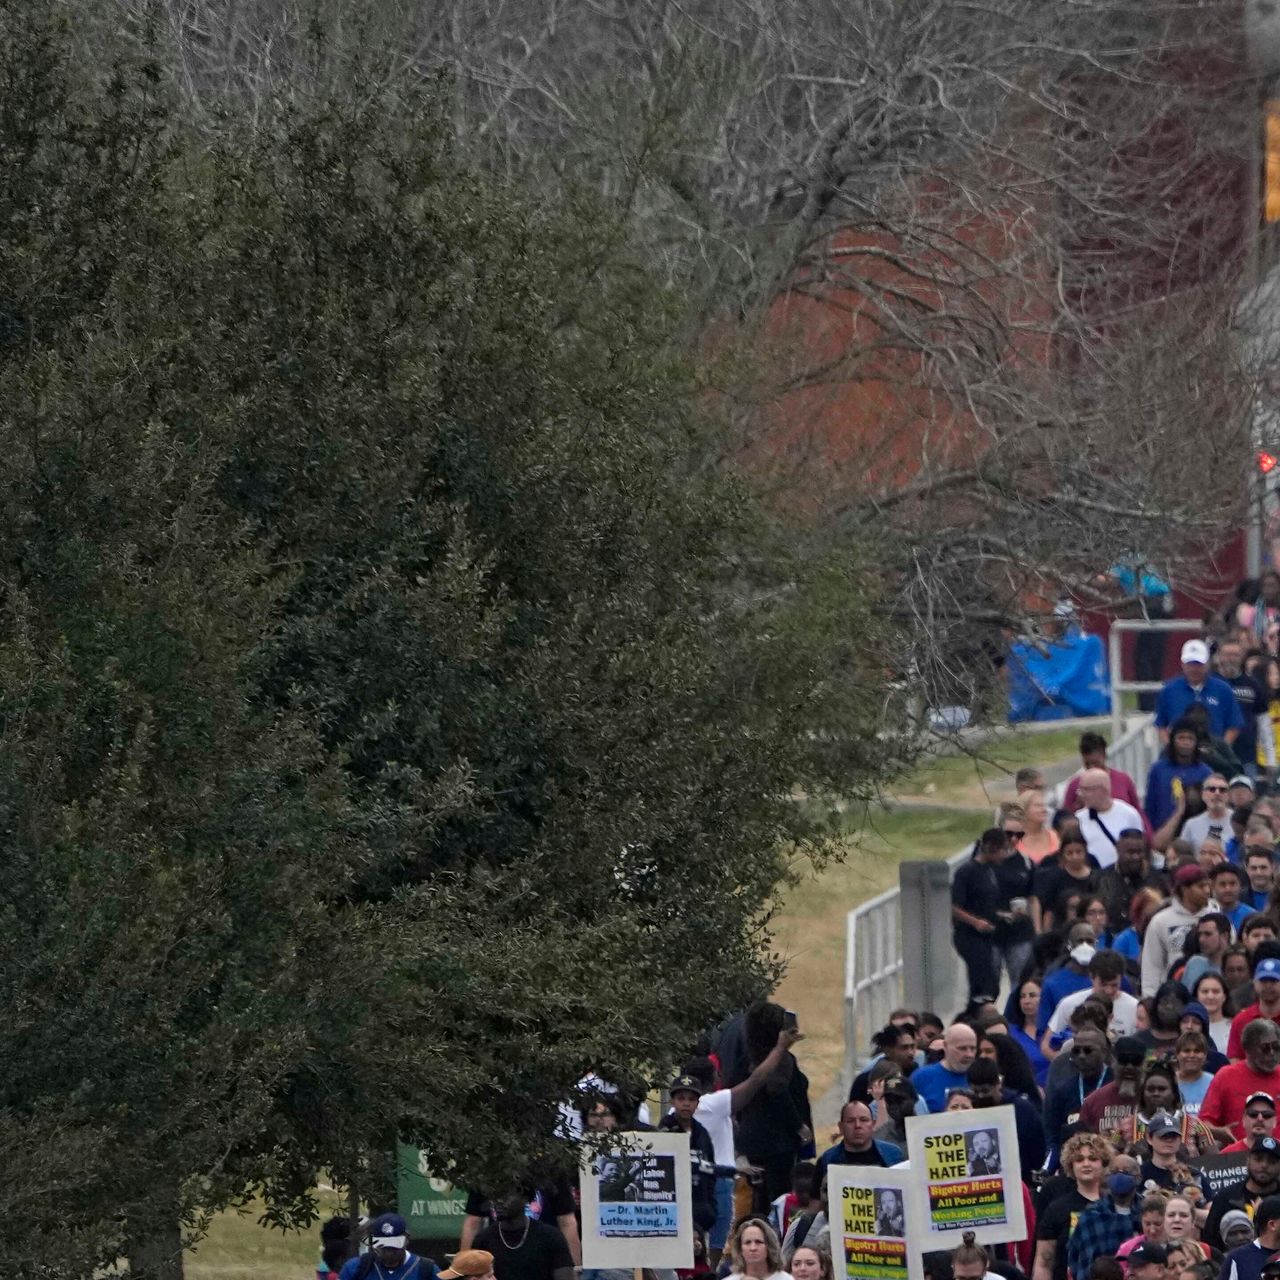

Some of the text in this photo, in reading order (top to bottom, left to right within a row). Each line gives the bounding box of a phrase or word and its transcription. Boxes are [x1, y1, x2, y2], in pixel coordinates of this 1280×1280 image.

[924, 1134, 963, 1149] STOP
[936, 1148, 964, 1163] THE
[929, 1163, 966, 1180] HATE
[842, 1187, 872, 1200] STOP
[930, 1180, 1002, 1197] Bigotry Hurts
[937, 1193, 997, 1207] All Poor and
[410, 1200, 426, 1216] AT
[633, 1205, 668, 1216] Martin
[851, 1203, 873, 1217] THE
[600, 1216, 676, 1229] Luther King, Jr.
[845, 1219, 875, 1234] HATE
